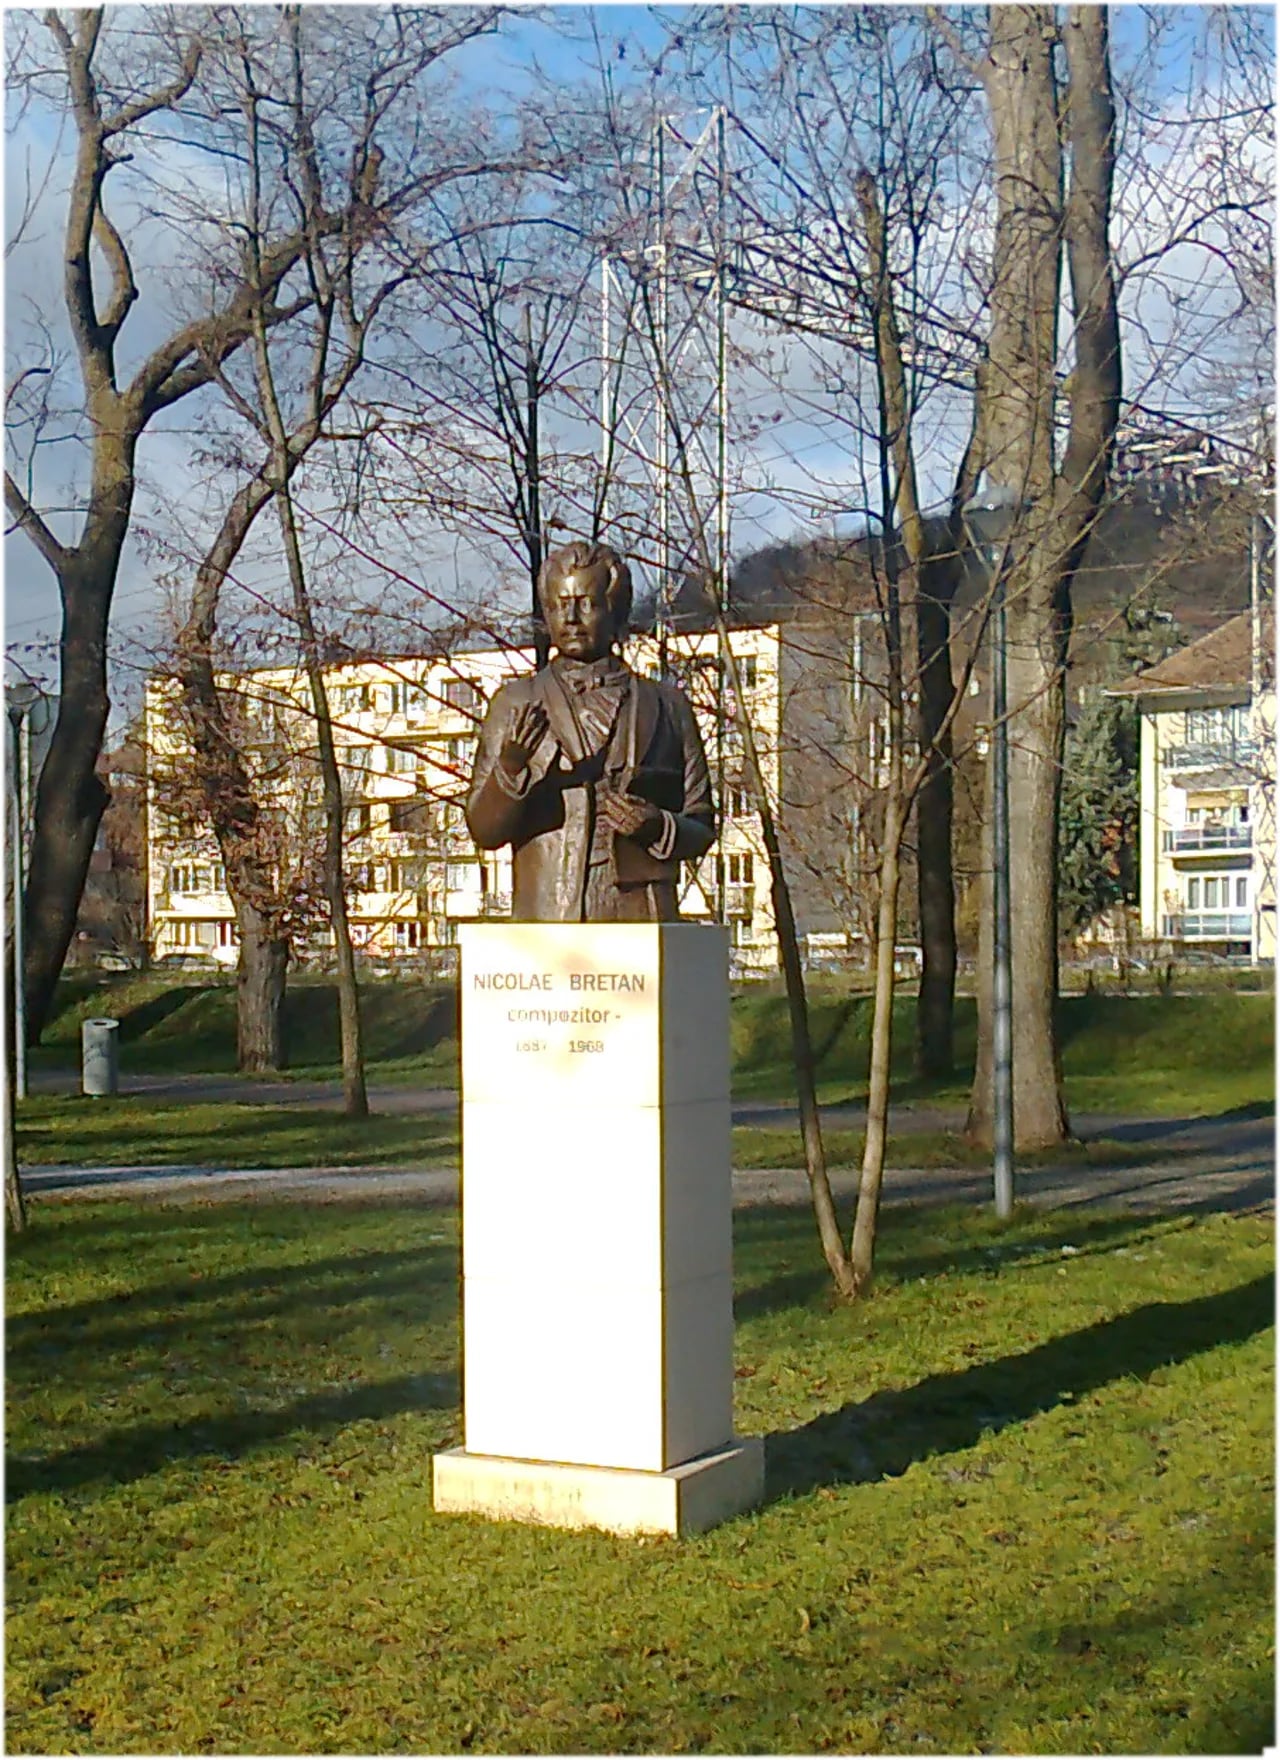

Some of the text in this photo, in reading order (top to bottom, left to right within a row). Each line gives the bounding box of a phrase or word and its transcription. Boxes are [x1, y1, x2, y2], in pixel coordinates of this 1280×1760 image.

[473, 973, 646, 992] NICOLAE BRETAN
[507, 1007, 610, 1026] compozitor
[568, 1040, 605, 1054] 1968
